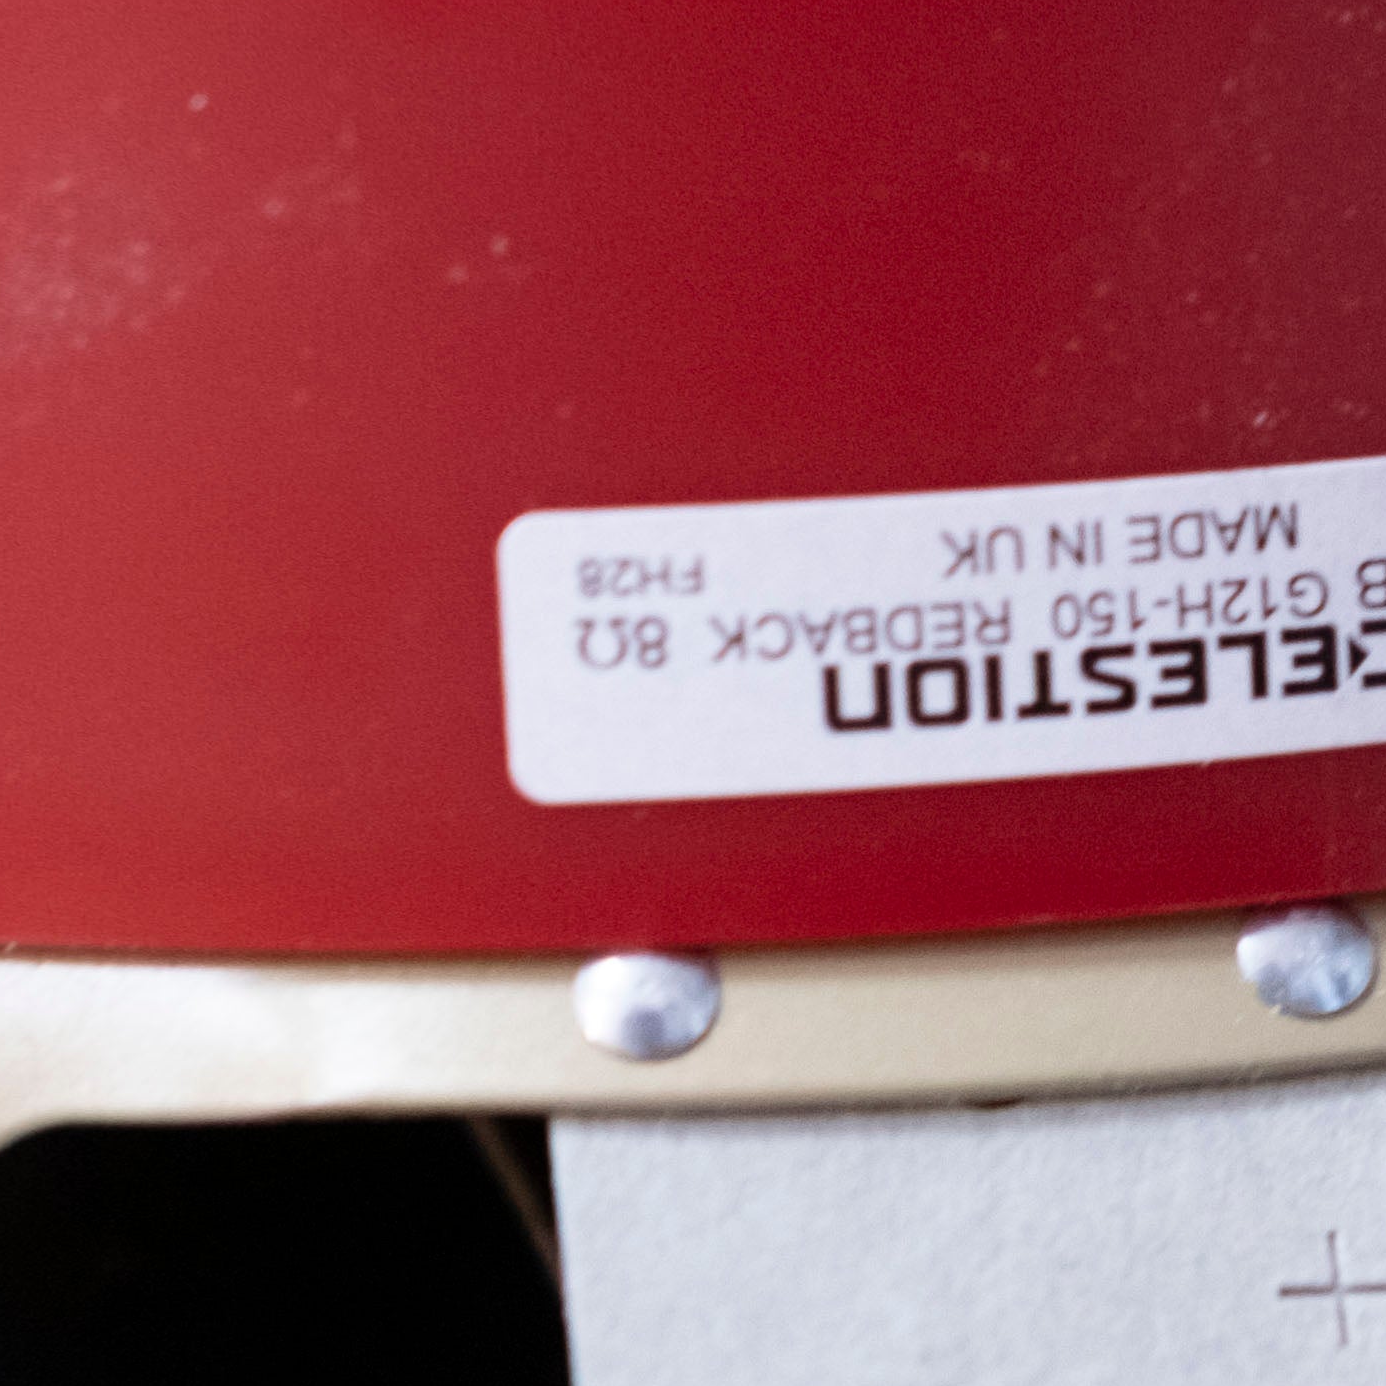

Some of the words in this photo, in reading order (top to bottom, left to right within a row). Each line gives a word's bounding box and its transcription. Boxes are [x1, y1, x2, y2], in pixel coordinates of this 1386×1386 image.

[943, 525, 1025, 577] UK
[1047, 521, 1104, 569] IN
[1128, 502, 1300, 566] MADE
[577, 555, 705, 599] FH28
[712, 600, 1012, 661] REDBACK
[1051, 570, 1330, 641] G12H-150
[575, 615, 669, 670] 8Ω
